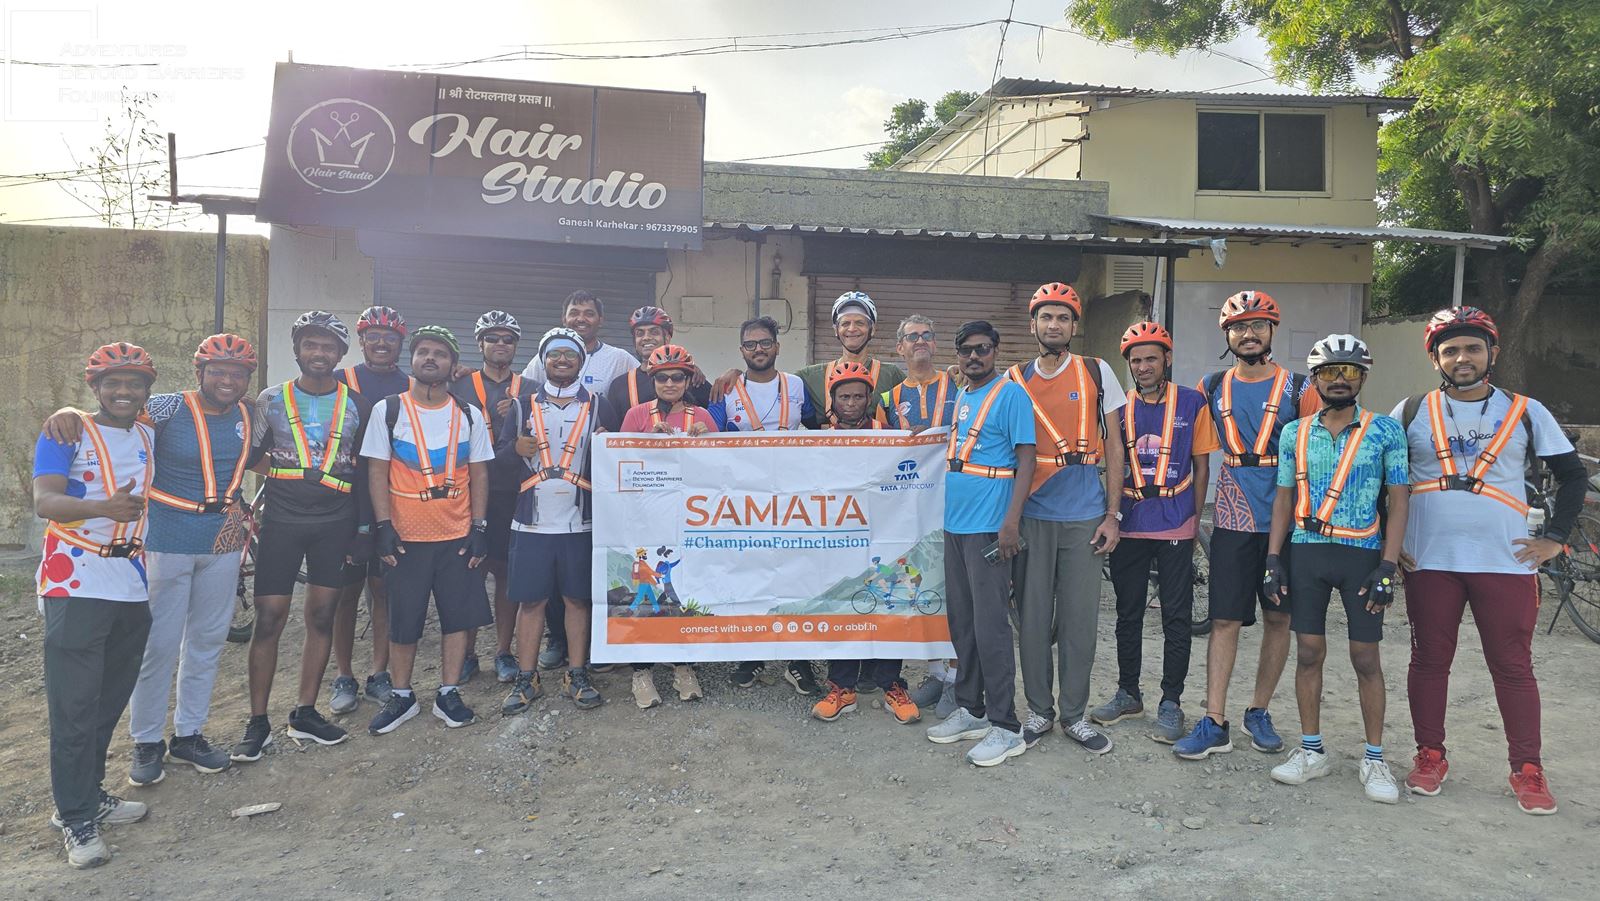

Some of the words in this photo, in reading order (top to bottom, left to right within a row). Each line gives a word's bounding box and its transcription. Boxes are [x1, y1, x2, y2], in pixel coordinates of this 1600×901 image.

[449, 87, 462, 98] श्री
[408, 113, 583, 161] Hair
[303, 166, 336, 178] Hair
[338, 169, 374, 181] Studio
[481, 161, 667, 210] Studio
[558, 217, 593, 228] Ganesh
[596, 219, 638, 230] Karhekar
[646, 223, 698, 234] 9673379905
[894, 472, 920, 481] TATA
[685, 495, 868, 527] SAMATA
[684, 535, 870, 552] #ChampionForInclusion
[680, 624, 718, 634] connect
[720, 624, 740, 633] with
[742, 625, 753, 633] us
[755, 625, 767, 633] on
[845, 623, 878, 632] abbf.in
